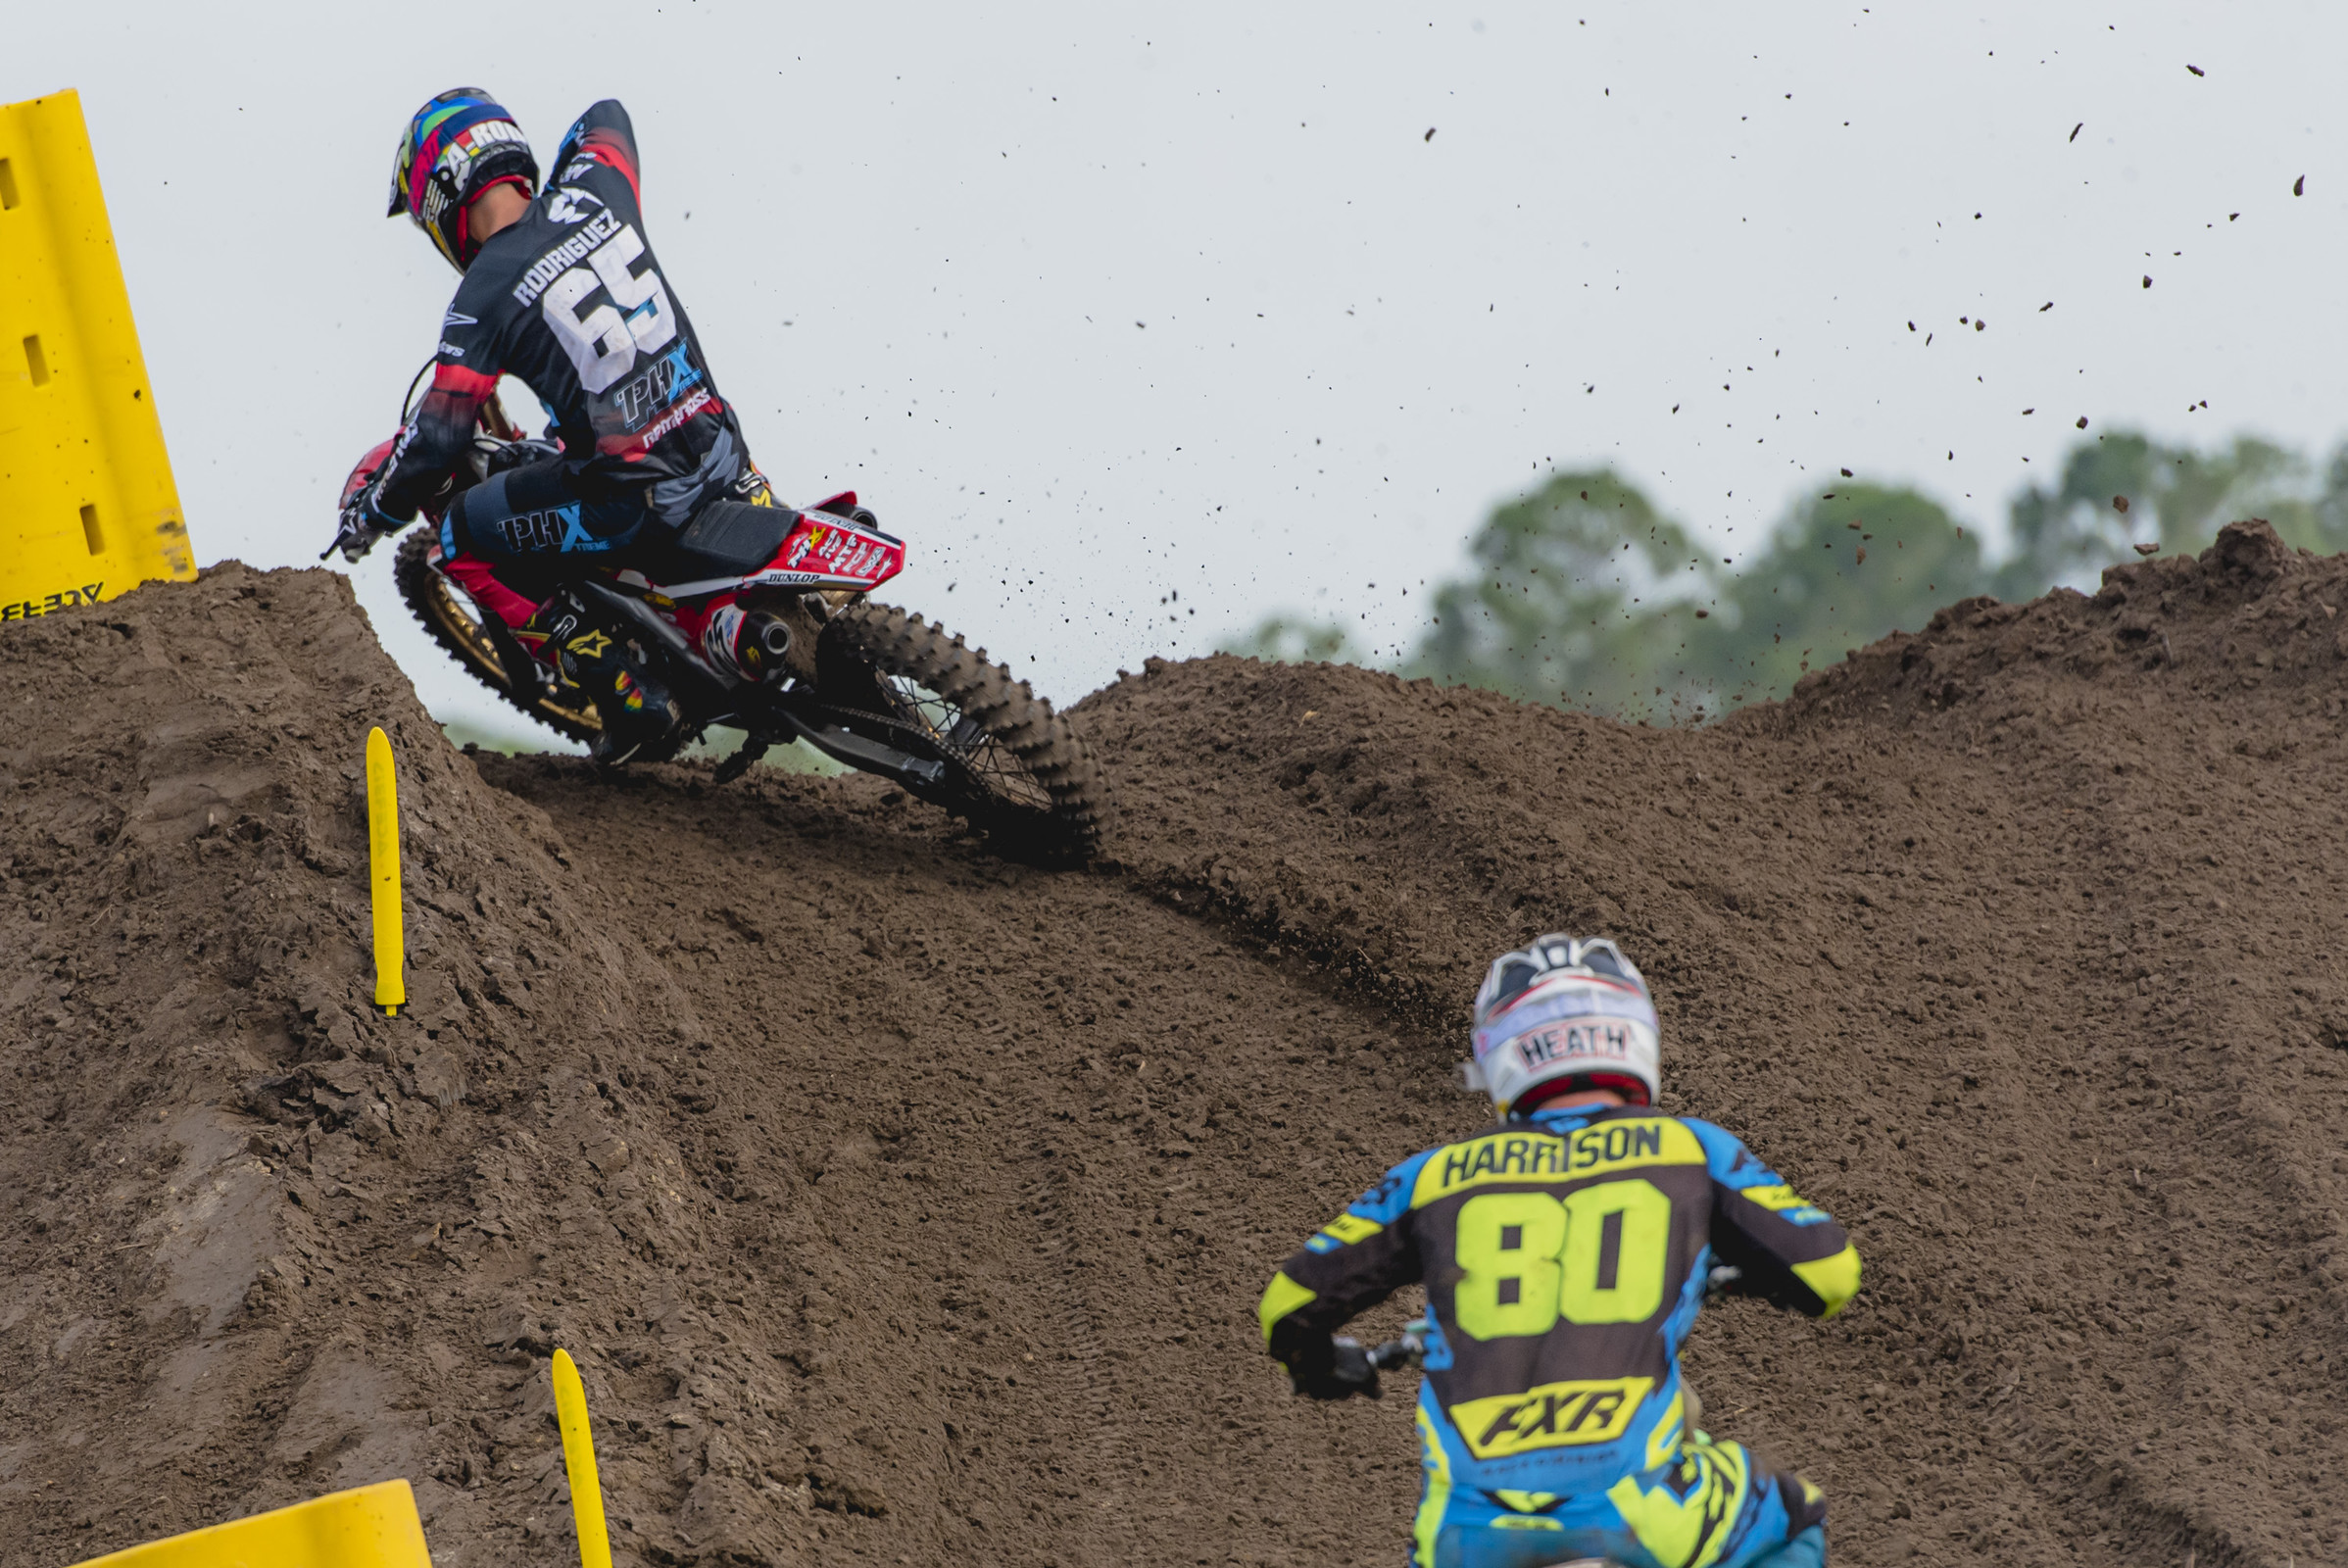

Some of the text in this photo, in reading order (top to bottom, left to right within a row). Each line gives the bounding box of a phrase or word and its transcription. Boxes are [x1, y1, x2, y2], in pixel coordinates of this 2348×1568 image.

[512, 208, 622, 308] RODRIGUEZ
[542, 223, 677, 394] 65
[496, 501, 593, 554] PHX
[768, 573, 821, 584] DUNLOP
[1520, 1026, 1625, 1066] HEATH
[1443, 1125, 1661, 1188] HARRISON
[1454, 1178, 1672, 1341] 80
[1478, 1389, 1626, 1447] FXR
